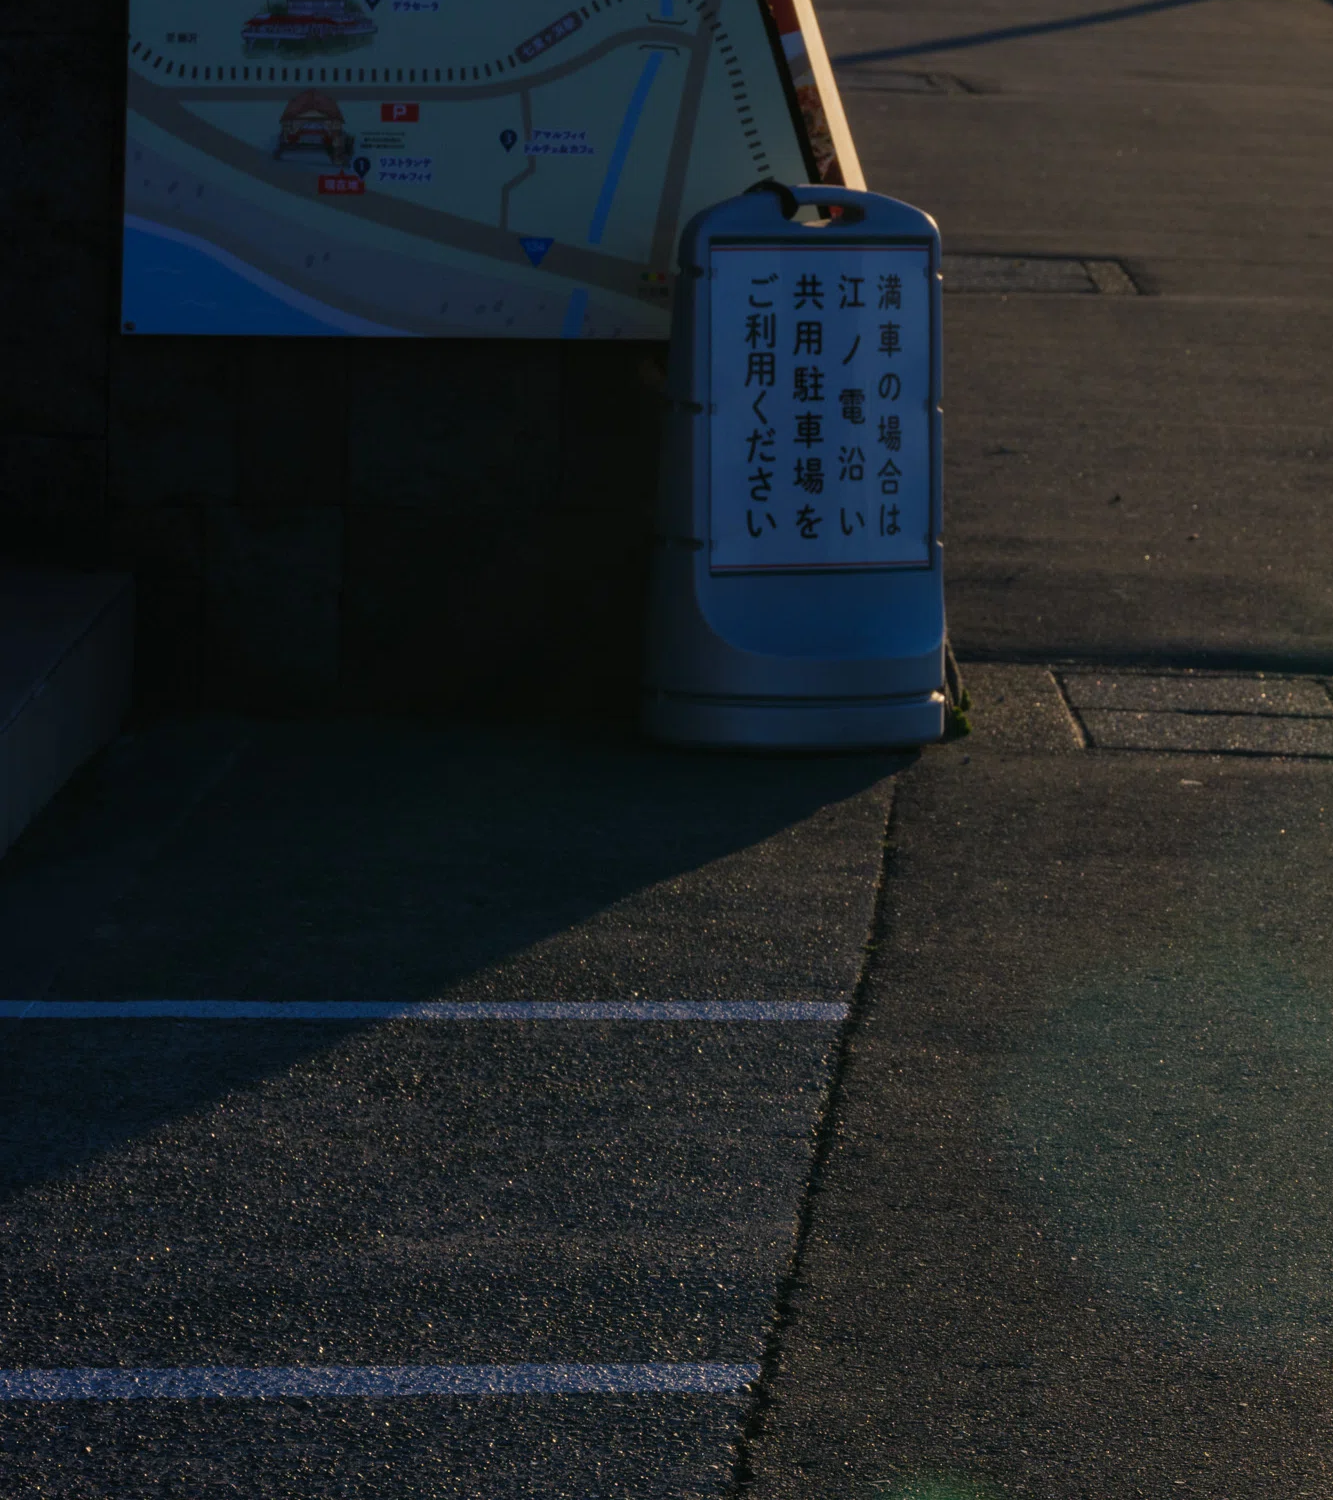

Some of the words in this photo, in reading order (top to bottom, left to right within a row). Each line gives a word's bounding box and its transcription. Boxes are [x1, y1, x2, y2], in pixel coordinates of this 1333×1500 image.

[393, 104, 407, 120] P
[745, 272, 779, 538] ご利用ください
[793, 273, 825, 539] 共用駐車場を
[838, 274, 867, 536] 江ノ電沿い
[877, 274, 902, 537] 満車の場合は
